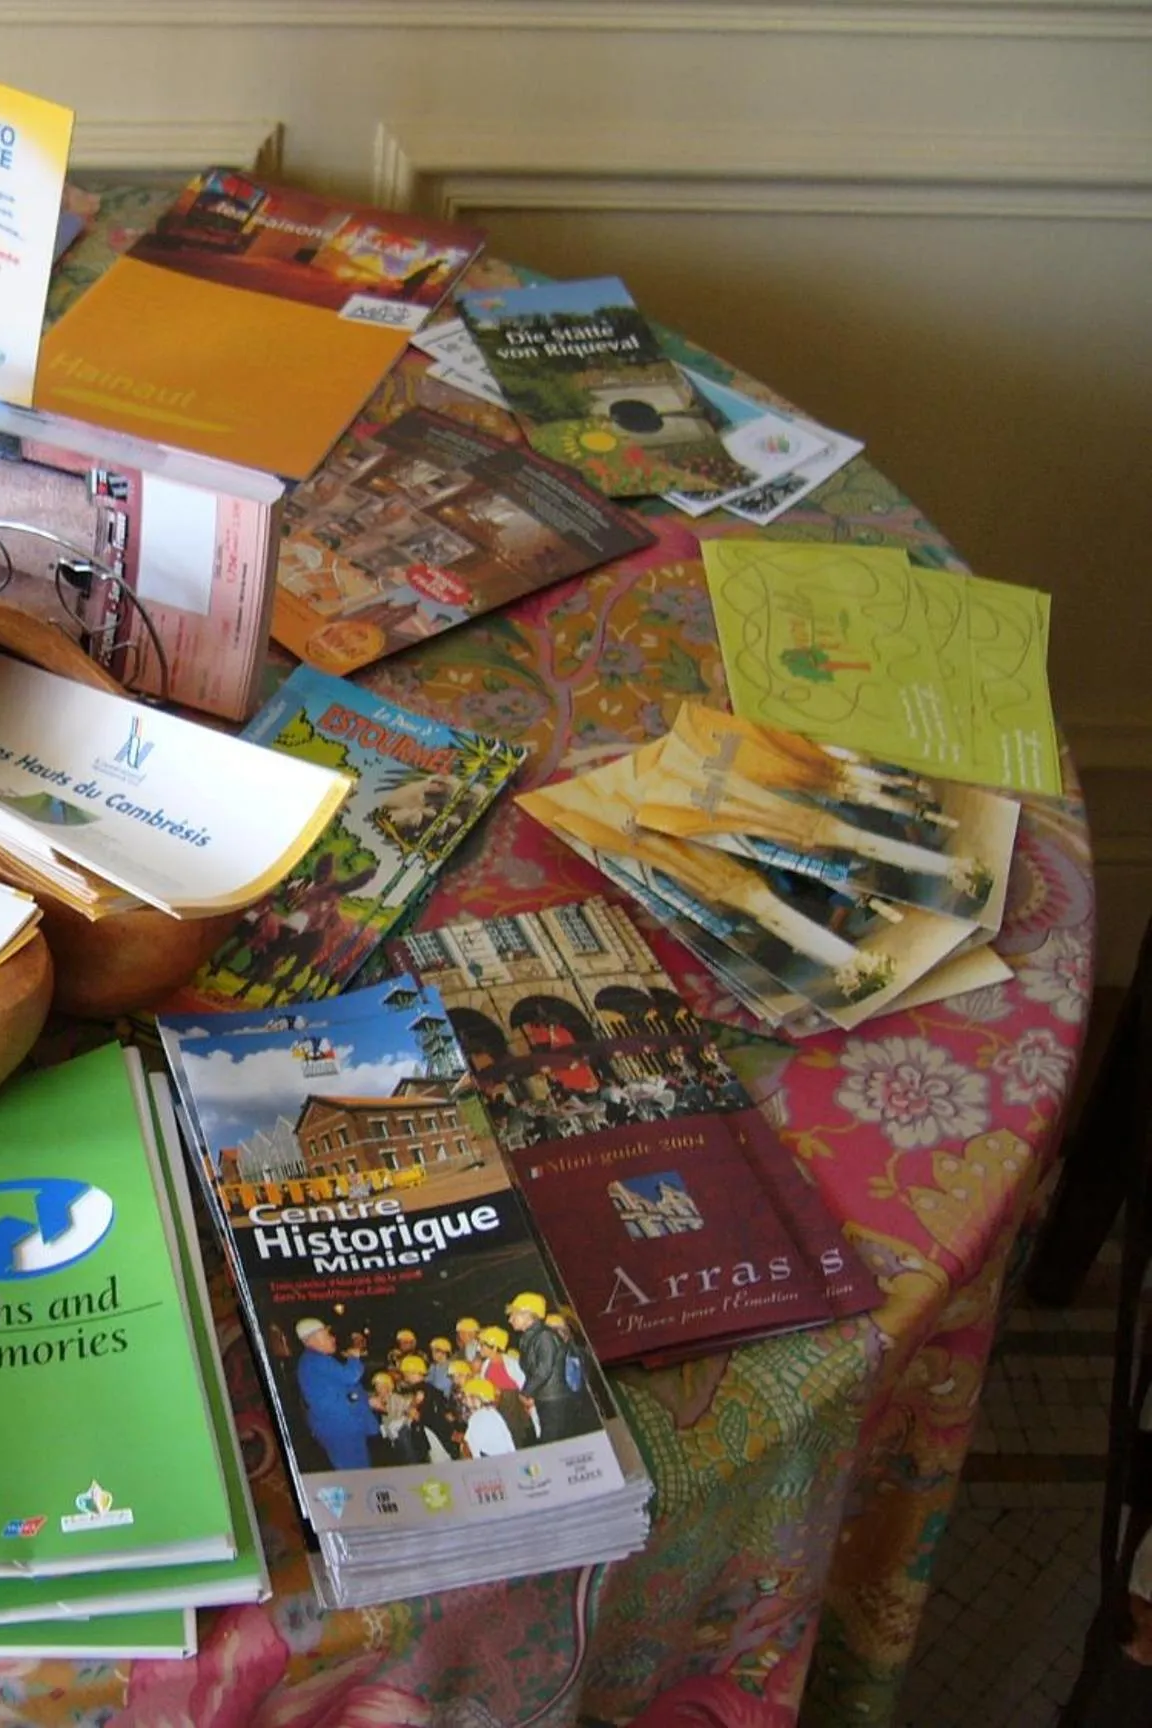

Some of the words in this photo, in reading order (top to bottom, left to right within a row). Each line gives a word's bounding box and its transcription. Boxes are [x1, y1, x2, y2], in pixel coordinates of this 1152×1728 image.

[496, 344, 539, 360] von
[505, 329, 544, 346] Die
[50, 351, 197, 409] Hainaut
[17, 751, 70, 786] Hauts
[72, 777, 102, 801] du
[103, 791, 213, 849] Cambrésis
[246, 1197, 403, 1226] Centre
[252, 1204, 501, 1260] Historique
[312, 1247, 438, 1275] Minier
[47, 1275, 122, 1317] and
[600, 1254, 793, 1316] Arras
